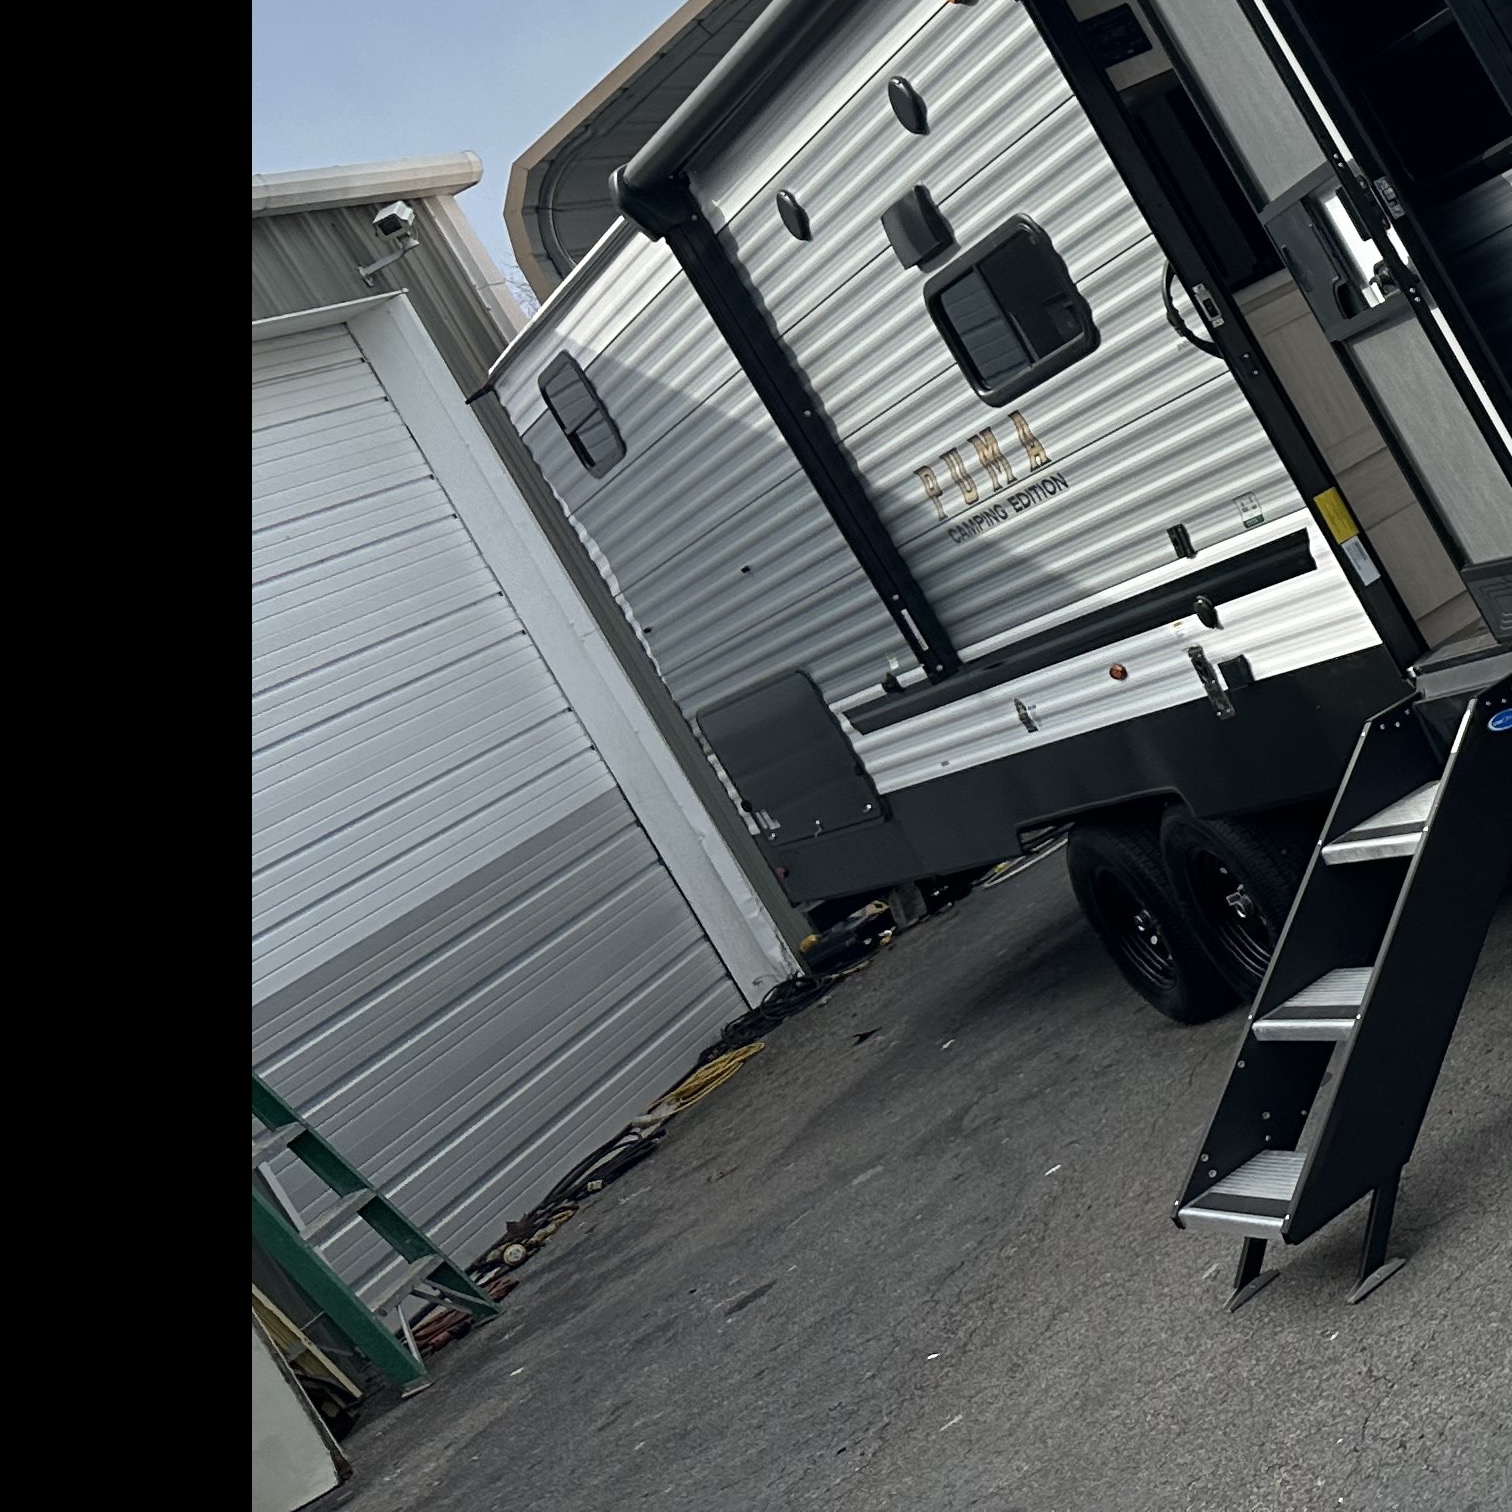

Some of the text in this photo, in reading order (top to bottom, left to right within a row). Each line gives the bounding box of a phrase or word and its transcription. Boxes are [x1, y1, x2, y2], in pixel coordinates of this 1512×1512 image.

[913, 409, 1052, 522] PUMA
[948, 472, 1070, 544] CAMPING EDITION
